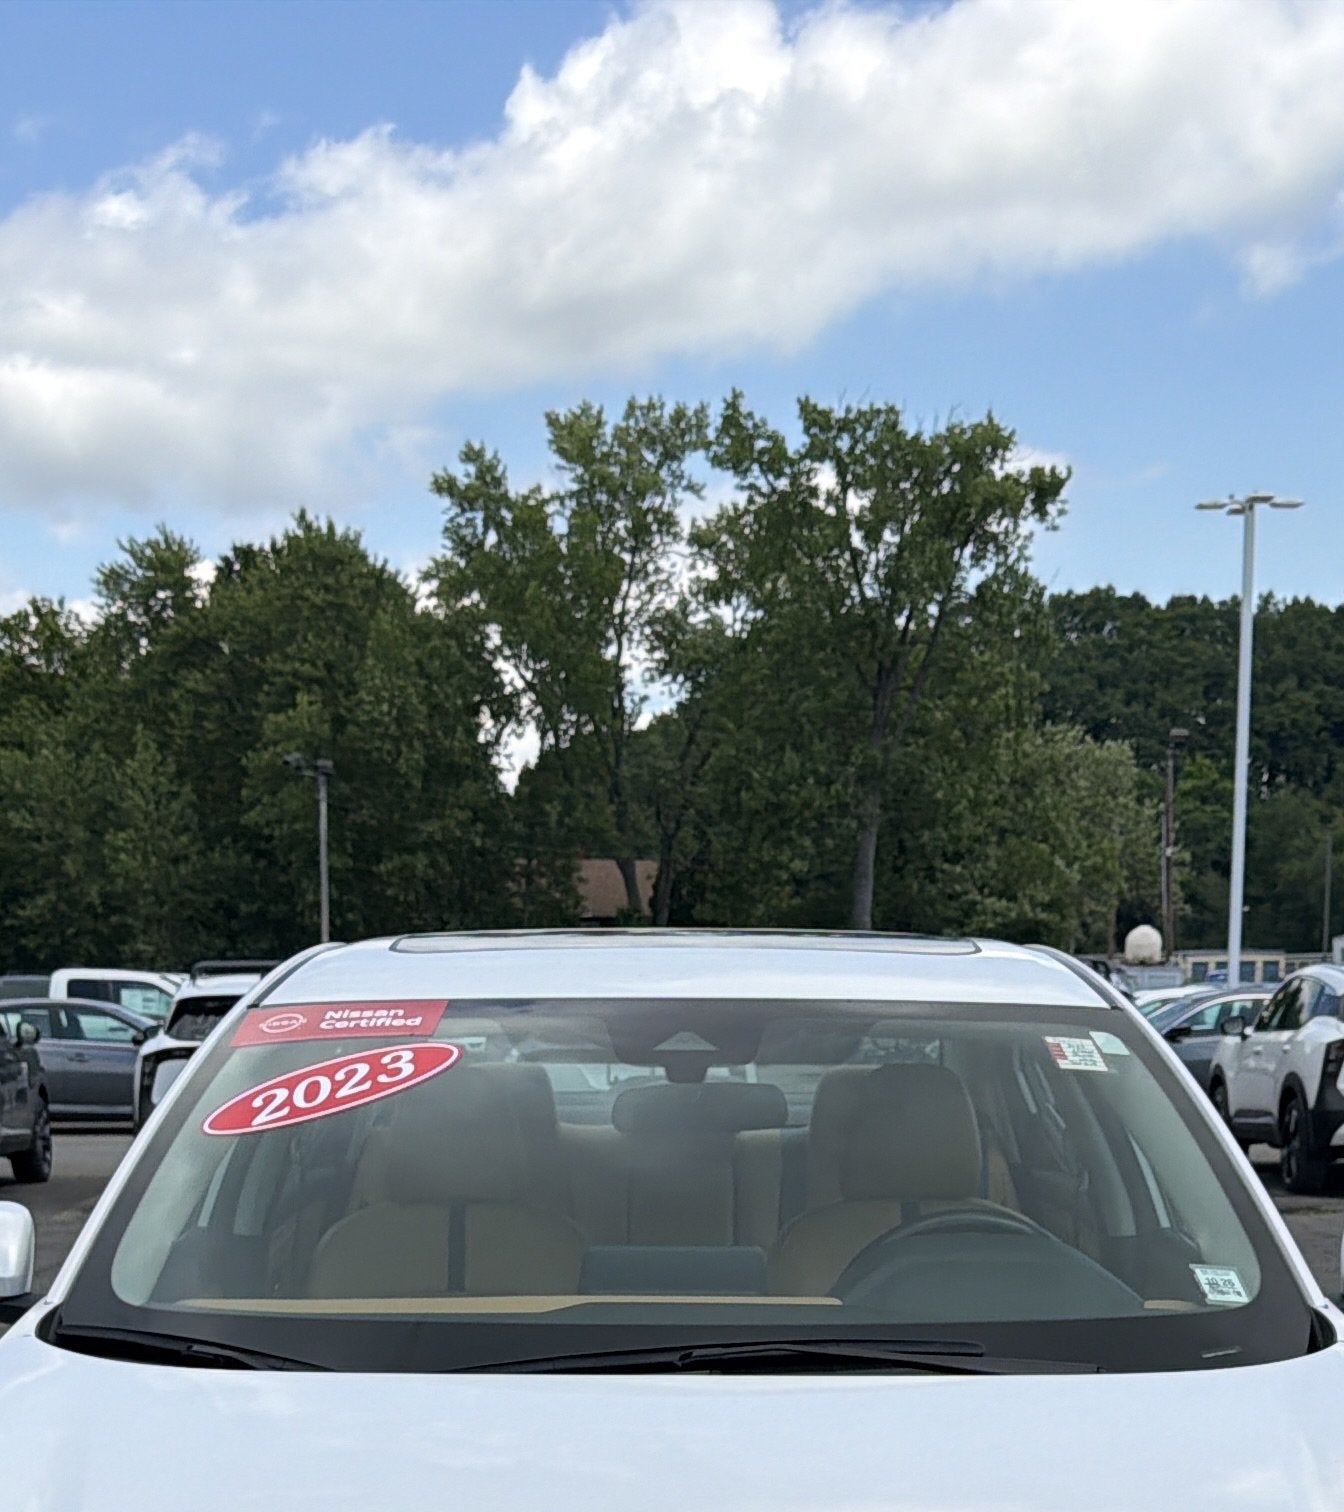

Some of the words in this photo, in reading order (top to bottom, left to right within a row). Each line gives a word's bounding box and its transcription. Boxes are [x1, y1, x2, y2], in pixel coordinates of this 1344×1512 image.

[324, 1008, 404, 1020] Nissan
[319, 1016, 422, 1030] Certified
[251, 1050, 415, 1127] 2023
